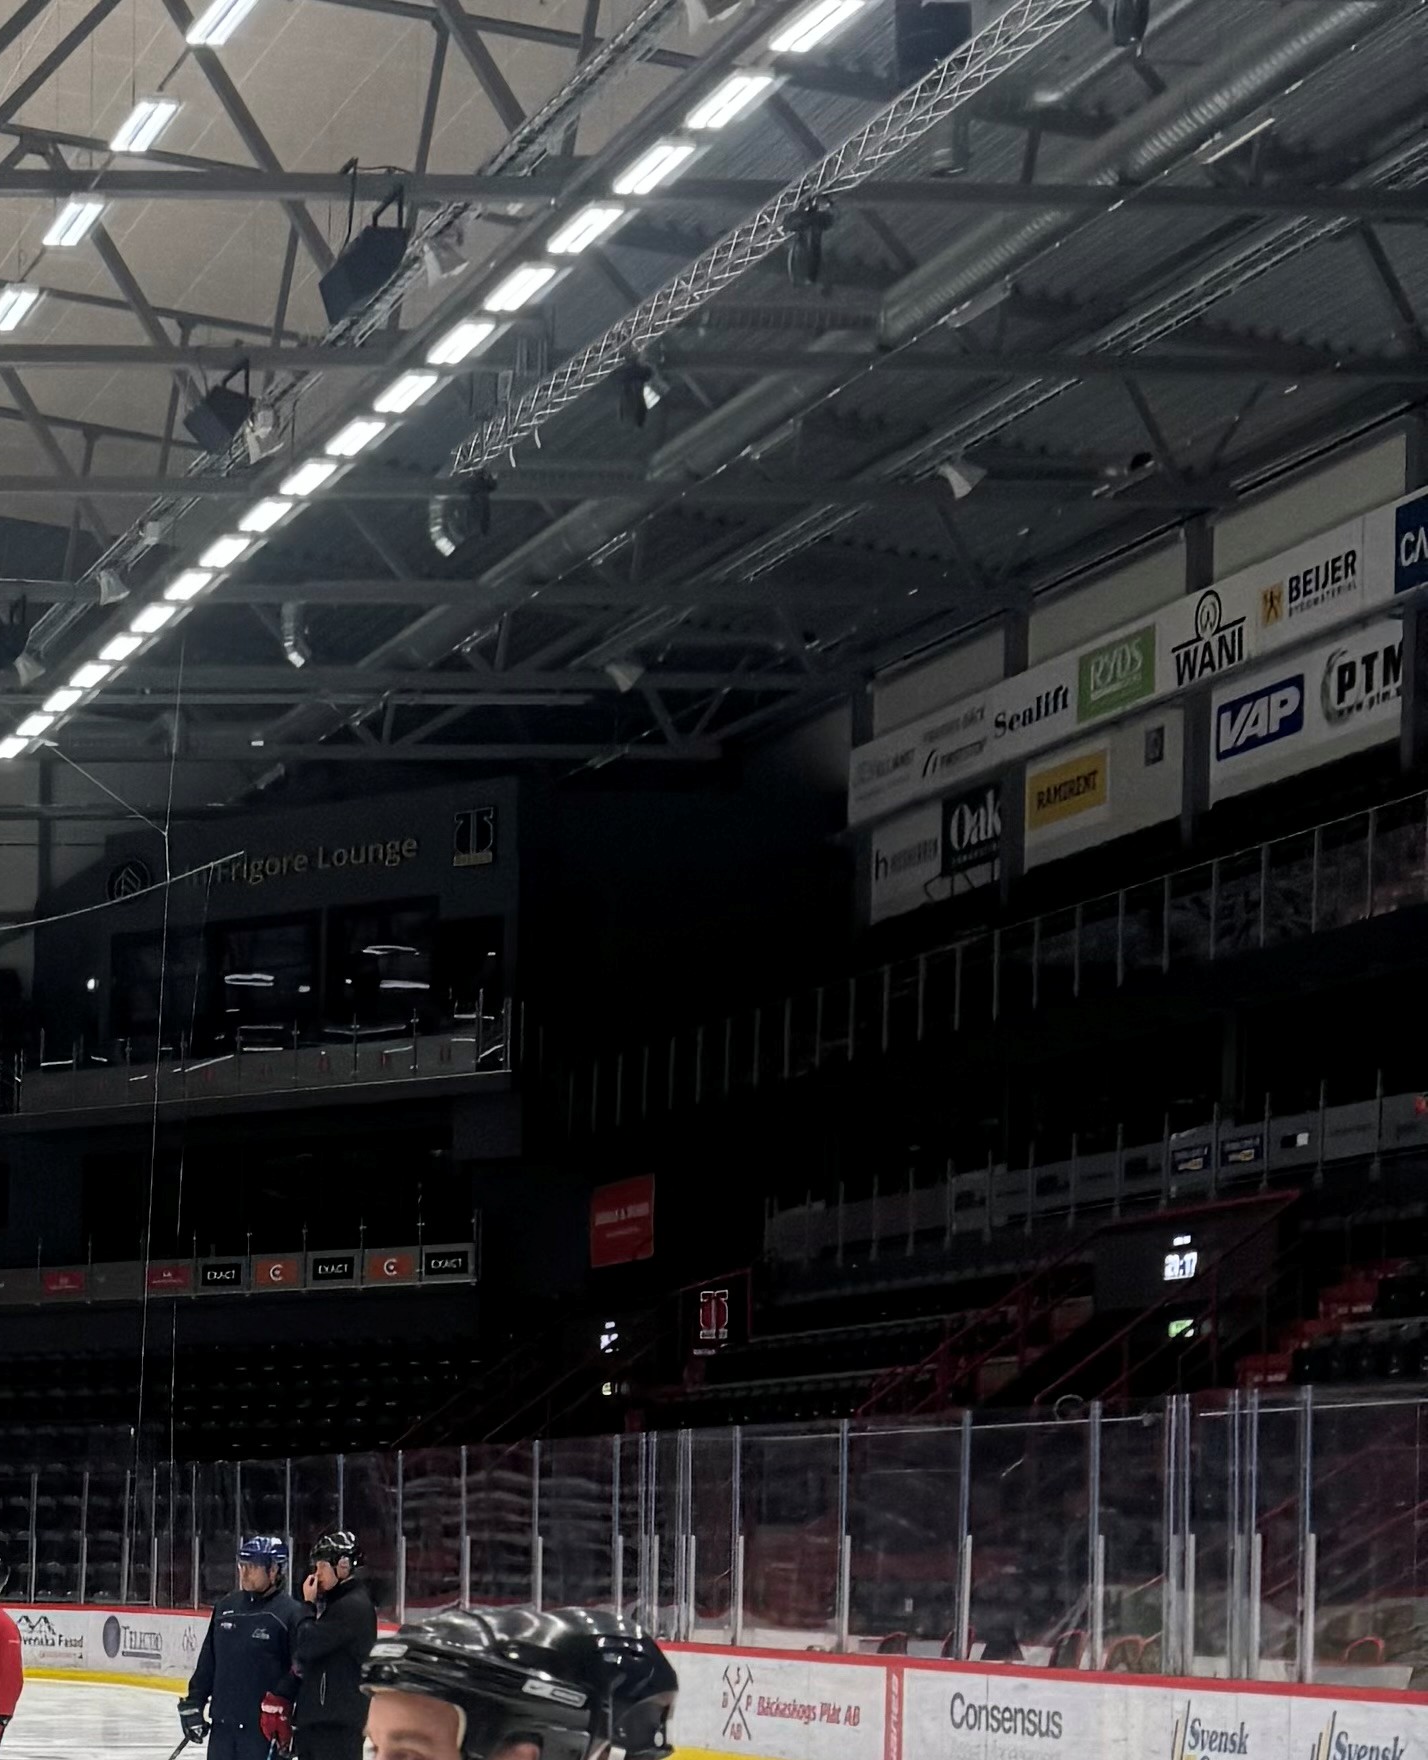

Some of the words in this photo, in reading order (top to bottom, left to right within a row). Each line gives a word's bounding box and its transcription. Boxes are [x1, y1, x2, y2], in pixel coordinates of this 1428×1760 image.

[1288, 550, 1357, 603] BEIJER
[1090, 637, 1144, 691] RYDS
[1175, 625, 1244, 686] WANI
[1219, 695, 1301, 755] VAP
[318, 836, 420, 870] Lounge
[22, 1633, 55, 1648] venska
[58, 1634, 84, 1648] Fasad
[844, 1705, 861, 1727] AB
[949, 1691, 1063, 1740] Consensus
[1187, 1717, 1250, 1757] Svensk
